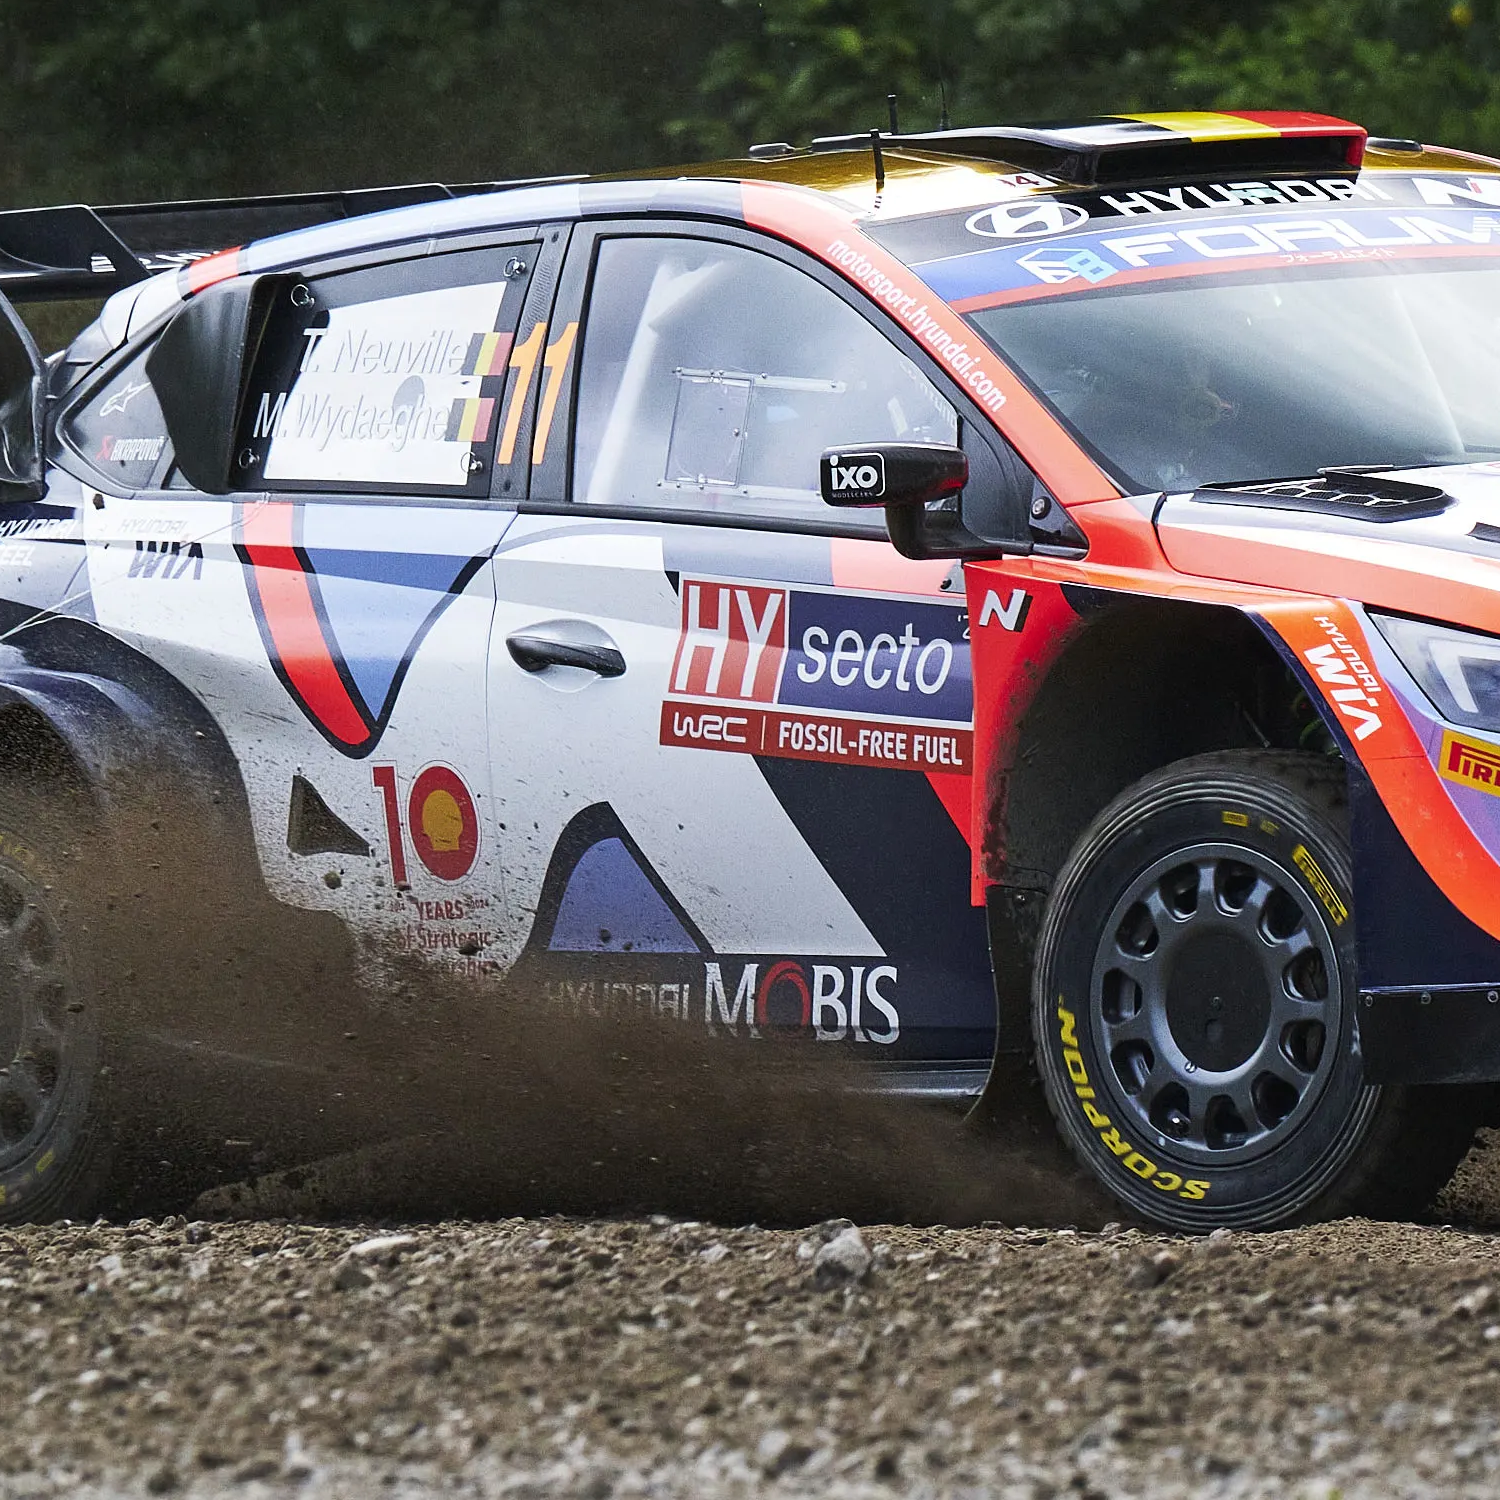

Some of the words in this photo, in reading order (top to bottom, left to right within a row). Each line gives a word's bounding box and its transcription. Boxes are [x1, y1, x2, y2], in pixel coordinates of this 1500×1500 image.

[1100, 177, 1394, 218] HYUNDAI
[333, 328, 468, 375] Neuville
[827, 239, 1008, 413] motorsport.hyundai.com
[298, 393, 449, 452] Wydaeghe
[497, 321, 580, 465] 11
[120, 518, 190, 534] HYUNDAI
[674, 584, 784, 699] HY
[978, 588, 1034, 633] N
[796, 622, 954, 695] secto
[1313, 615, 1382, 693] HYUNDAI
[1303, 643, 1383, 741] WIA
[673, 711, 749, 744] WRC
[779, 720, 908, 762] FOSSIL-FREE
[912, 732, 964, 767] FUEL
[411, 899, 464, 920] YEARS
[703, 960, 901, 1045] MOBIS
[1057, 1006, 1212, 1200] SCORPION
